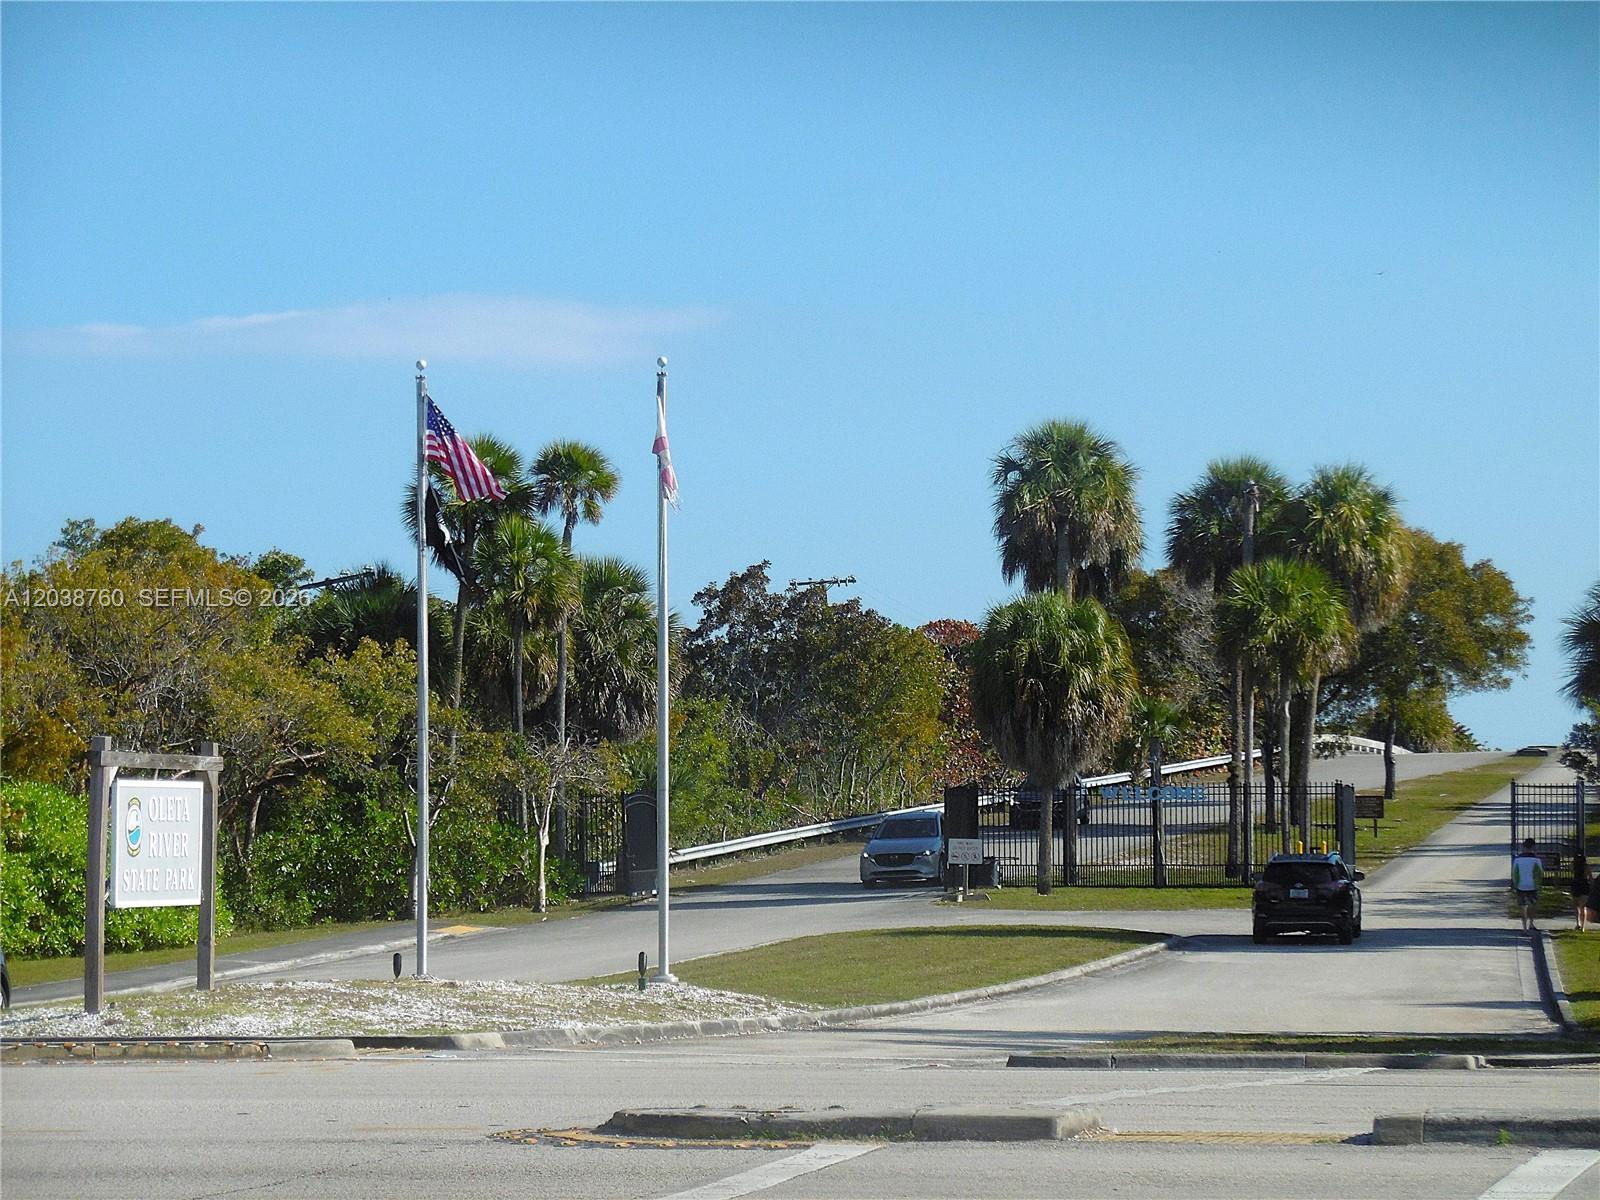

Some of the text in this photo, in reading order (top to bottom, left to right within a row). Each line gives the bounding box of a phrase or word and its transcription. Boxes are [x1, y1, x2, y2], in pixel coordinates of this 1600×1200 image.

[1101, 786, 1205, 801] WELCOME
[148, 795, 191, 822] OLETA
[148, 832, 188, 857] RIVER
[122, 867, 195, 892] STATE PARK
